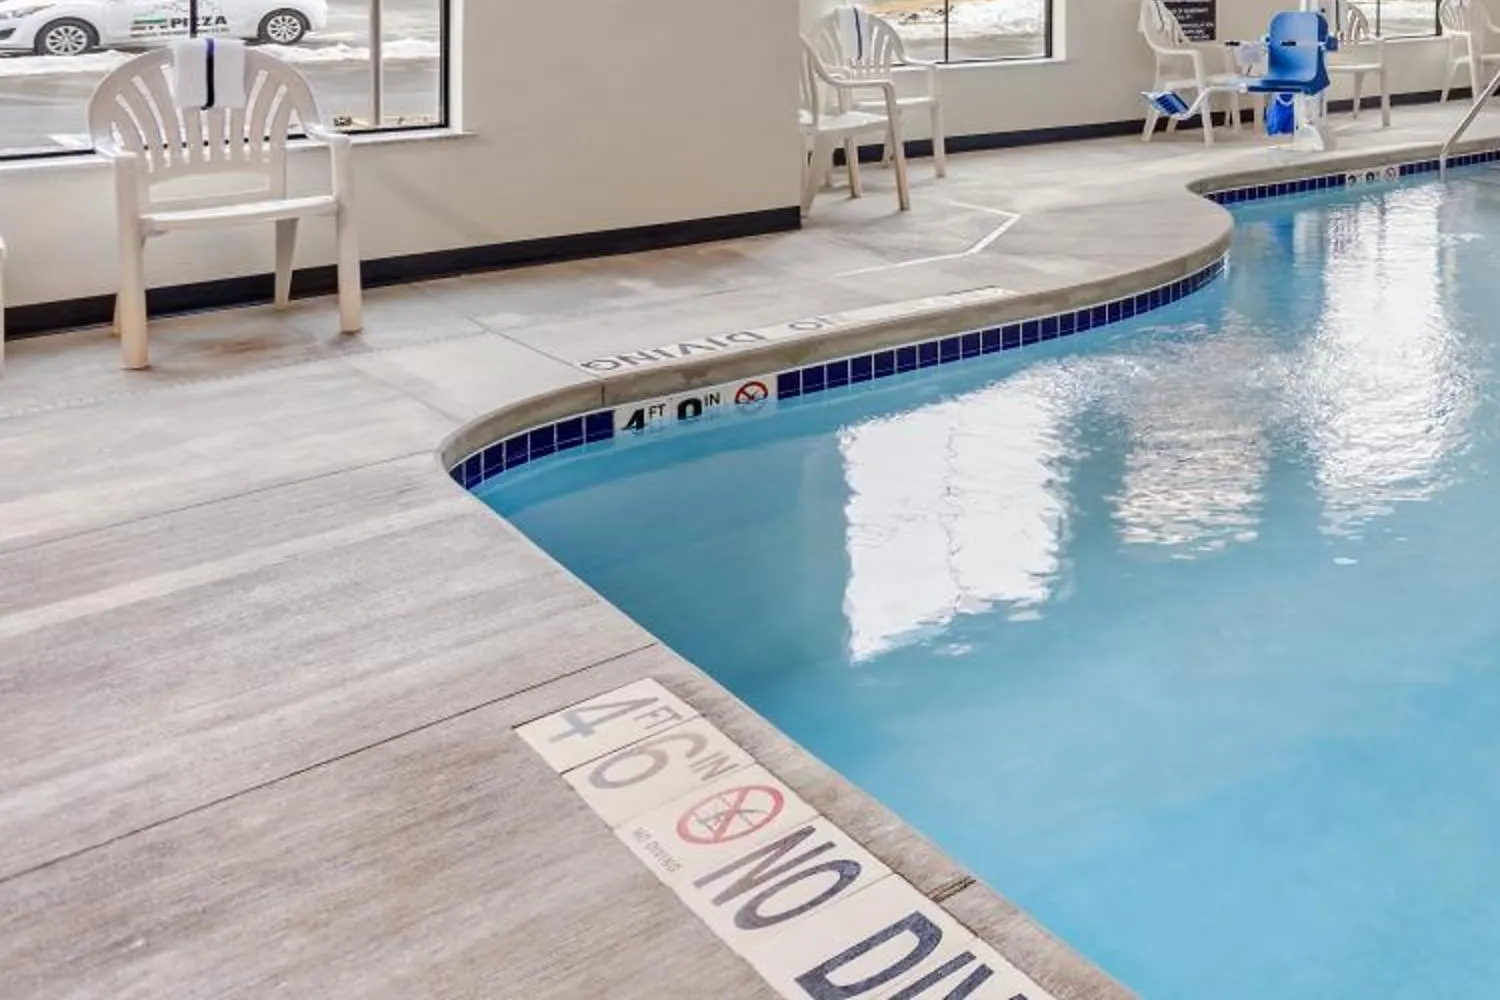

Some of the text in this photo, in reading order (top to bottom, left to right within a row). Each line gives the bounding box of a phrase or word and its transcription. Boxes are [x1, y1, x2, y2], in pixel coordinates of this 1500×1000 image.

[170, 15, 228, 28] PIZA
[580, 330, 766, 372] DIVING
[648, 403, 667, 419] FT
[704, 392, 720, 407] IN
[548, 696, 683, 743] 4 FT
[588, 732, 739, 789] 6 IN
[694, 825, 862, 931] NO
